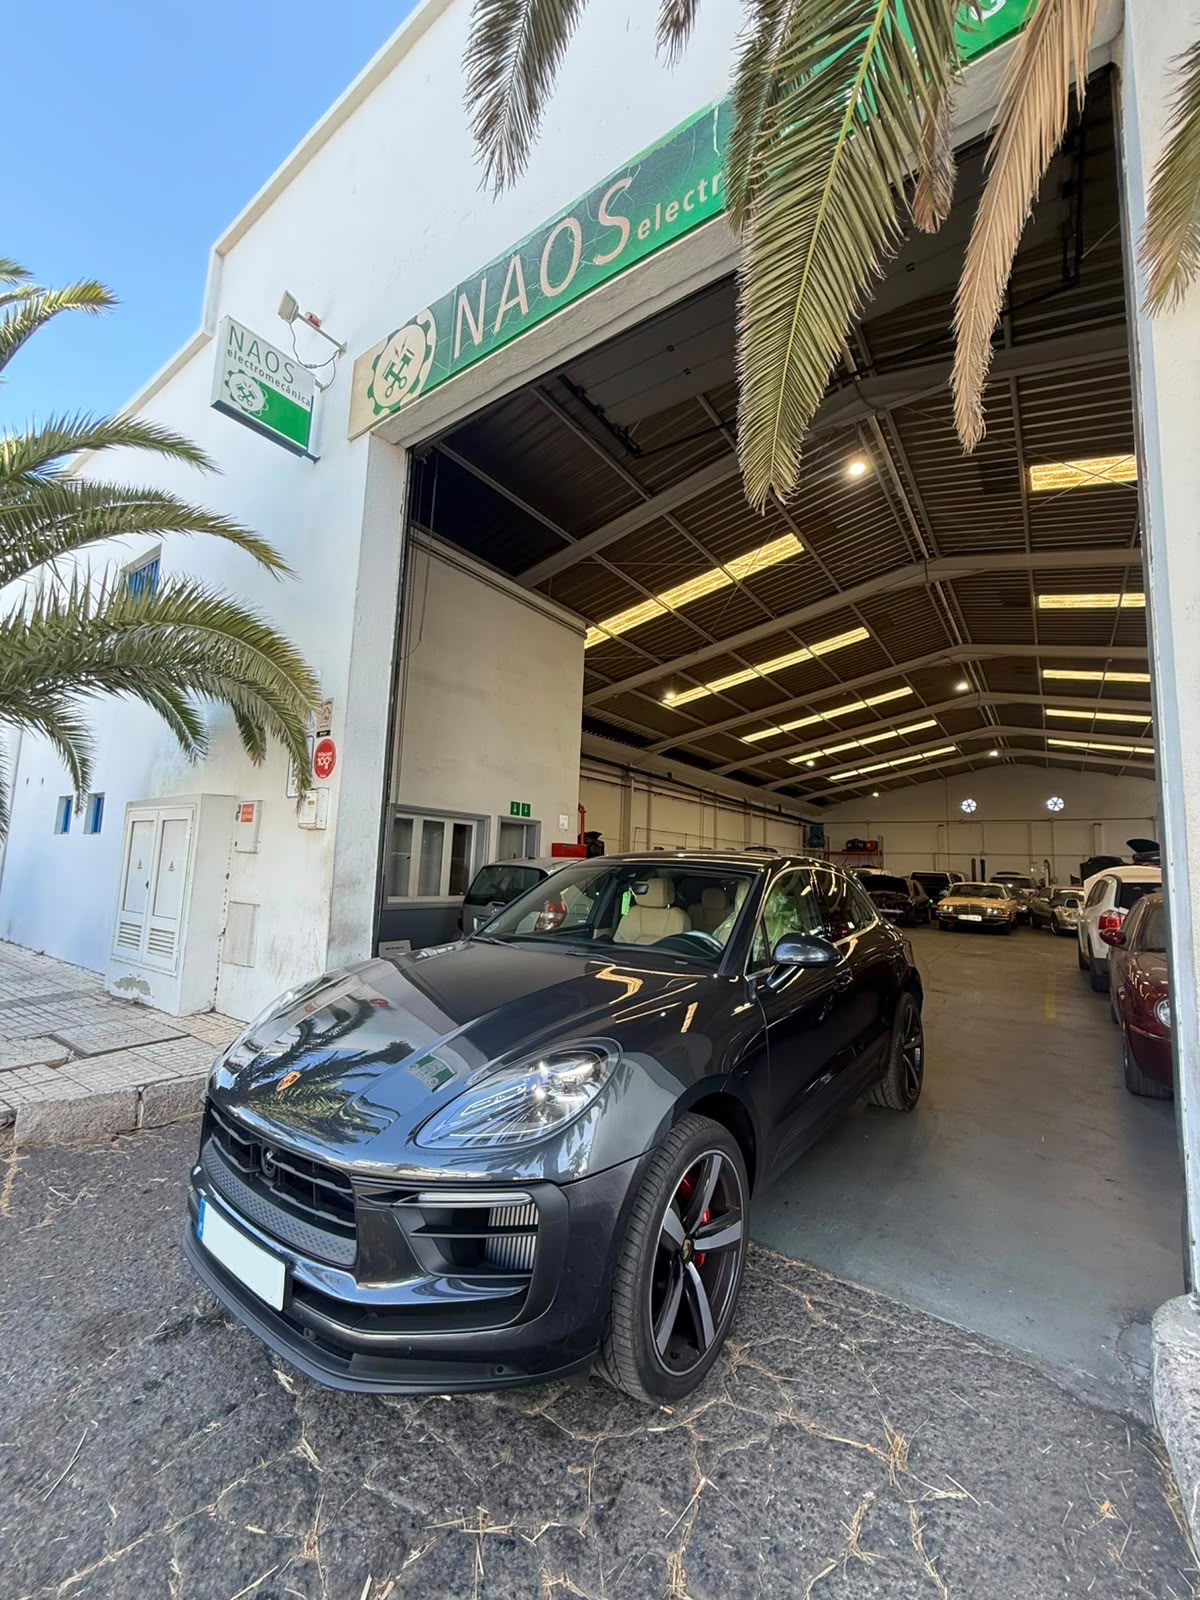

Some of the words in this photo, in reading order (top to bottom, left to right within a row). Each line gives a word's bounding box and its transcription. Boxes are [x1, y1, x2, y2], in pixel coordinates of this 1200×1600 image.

[453, 177, 632, 359] NAOS
[637, 173, 722, 240] electr
[227, 348, 310, 406] electromecánica
[229, 325, 294, 384] NAOS
